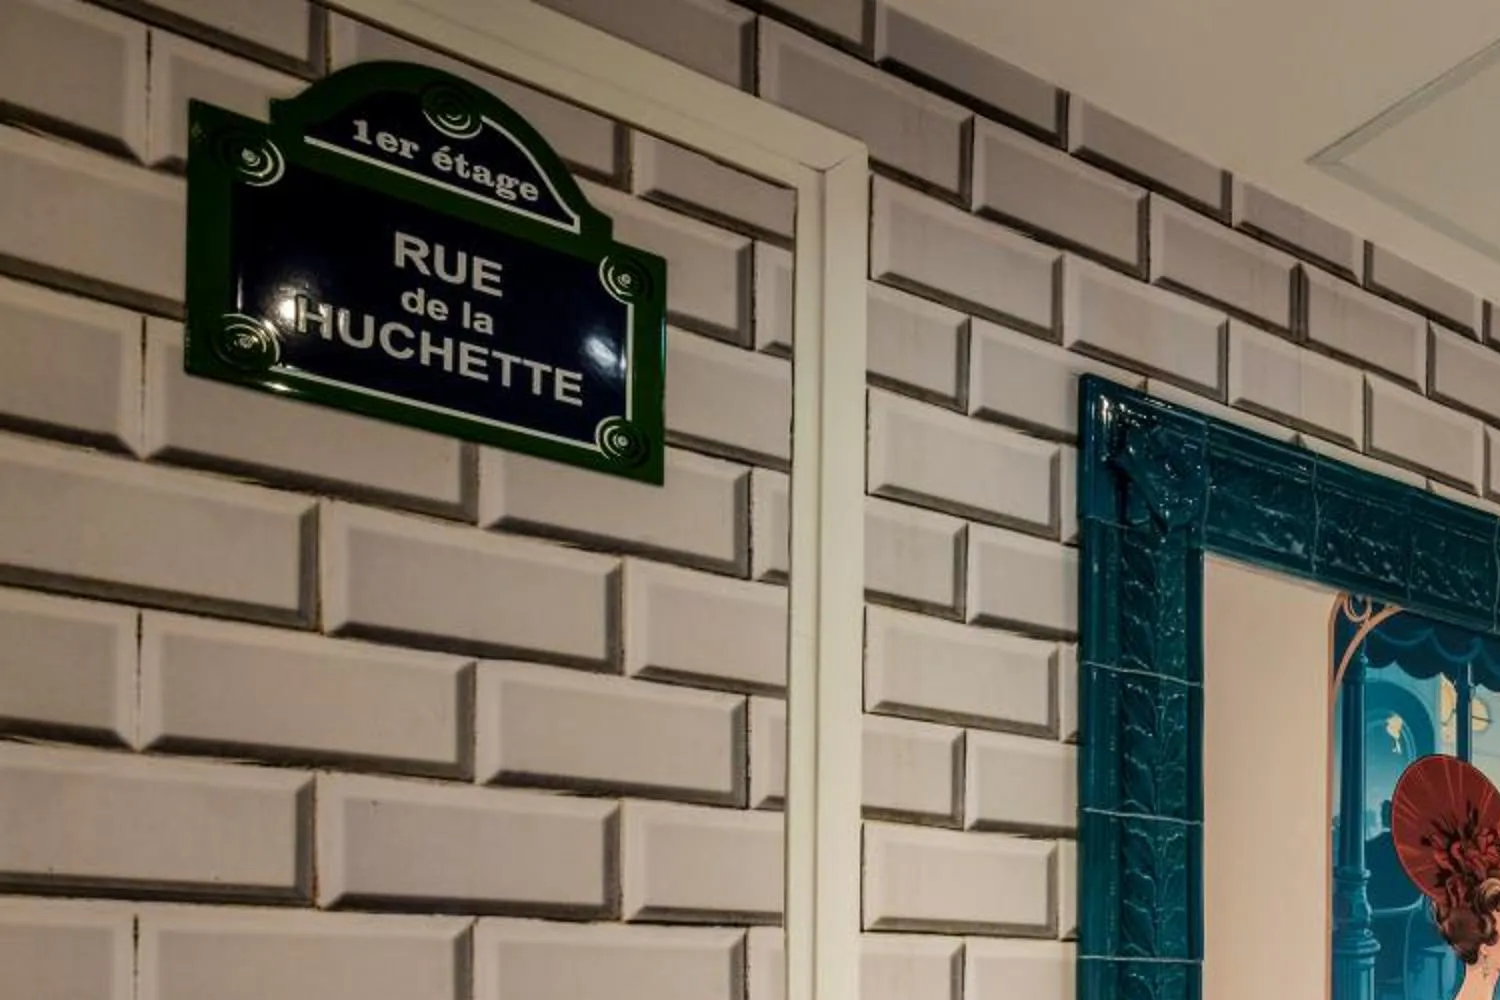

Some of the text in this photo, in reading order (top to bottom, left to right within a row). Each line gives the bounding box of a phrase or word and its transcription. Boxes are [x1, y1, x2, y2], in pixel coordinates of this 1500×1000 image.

[353, 118, 539, 201] 1er étage
[393, 231, 504, 298] RUE
[401, 287, 495, 336] de la
[297, 295, 583, 408] HUCHETTE
